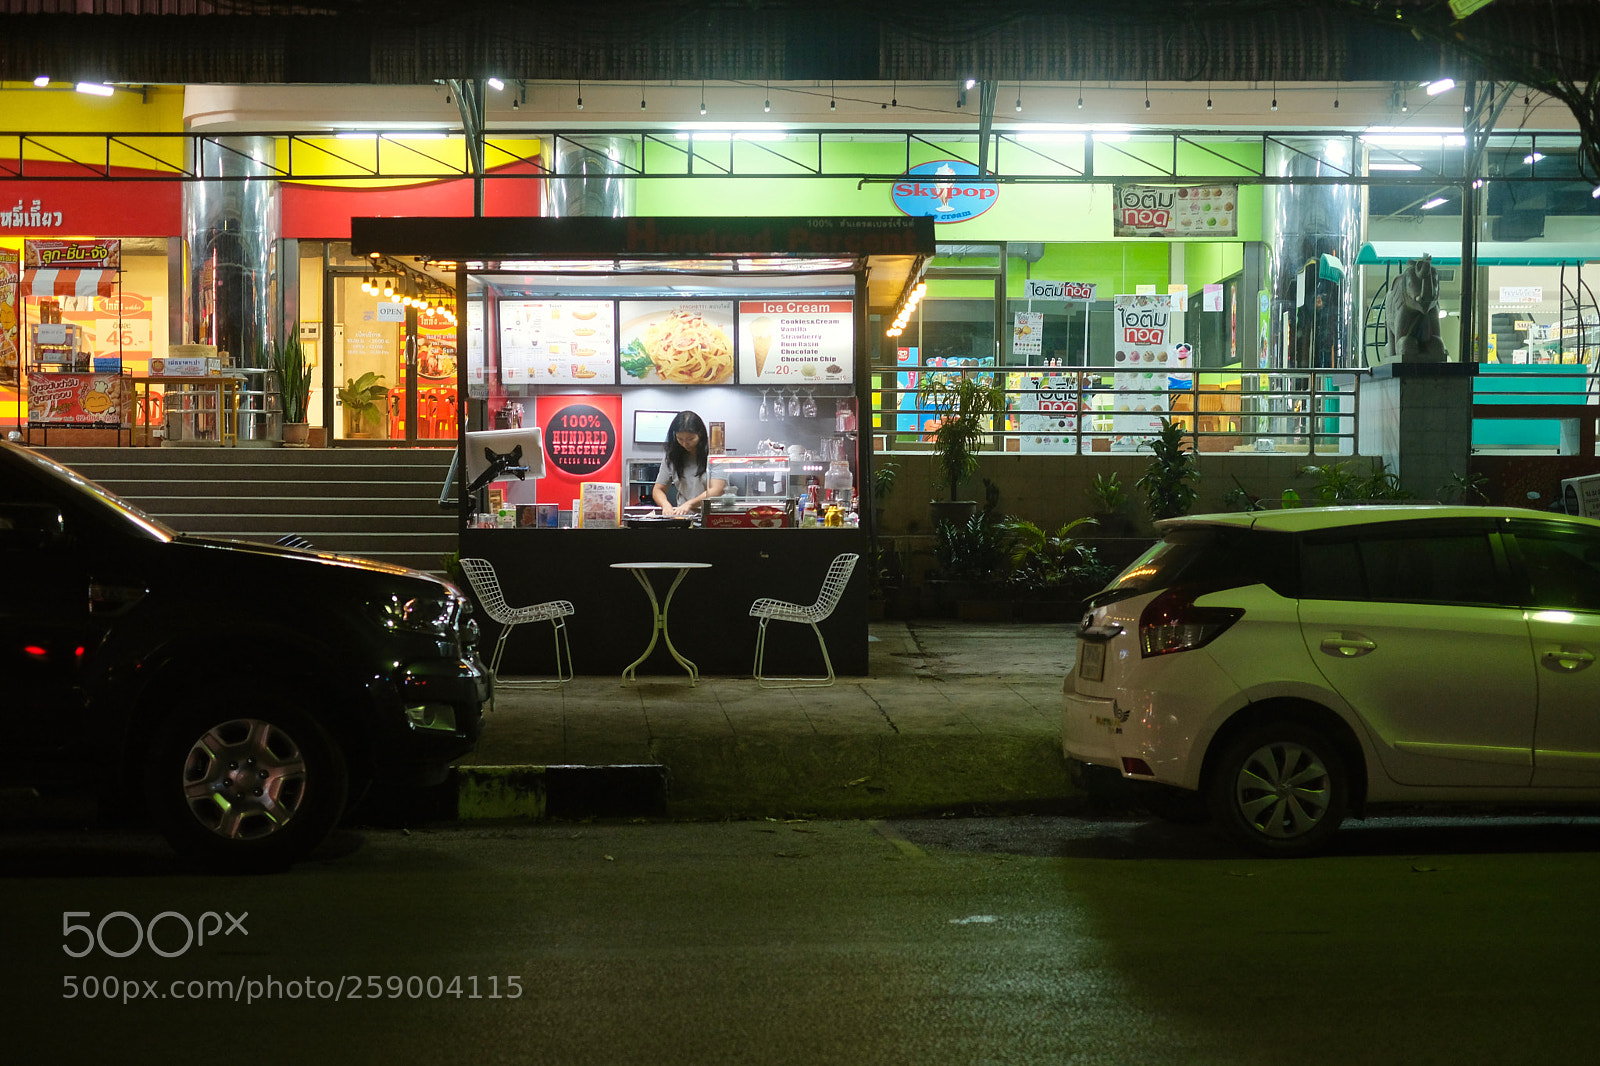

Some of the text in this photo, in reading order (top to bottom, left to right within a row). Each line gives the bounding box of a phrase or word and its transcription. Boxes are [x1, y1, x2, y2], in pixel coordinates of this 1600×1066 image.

[895, 183, 996, 199] Skypop
[941, 210, 971, 220] cream
[1124, 209, 1168, 227] ทอด
[626, 217, 917, 250] Hundred Percent
[1030, 282, 1091, 298] ไอติม ทอด
[380, 307, 403, 315] OPEN
[763, 302, 830, 313] Ice Cream
[1119, 309, 1167, 328] ไอติม
[1126, 330, 1162, 343] ทอด
[775, 365, 798, 375] 20.-
[561, 414, 601, 428] 100%
[552, 430, 608, 445] HUNDRED
[553, 445, 607, 455] PERCENT
